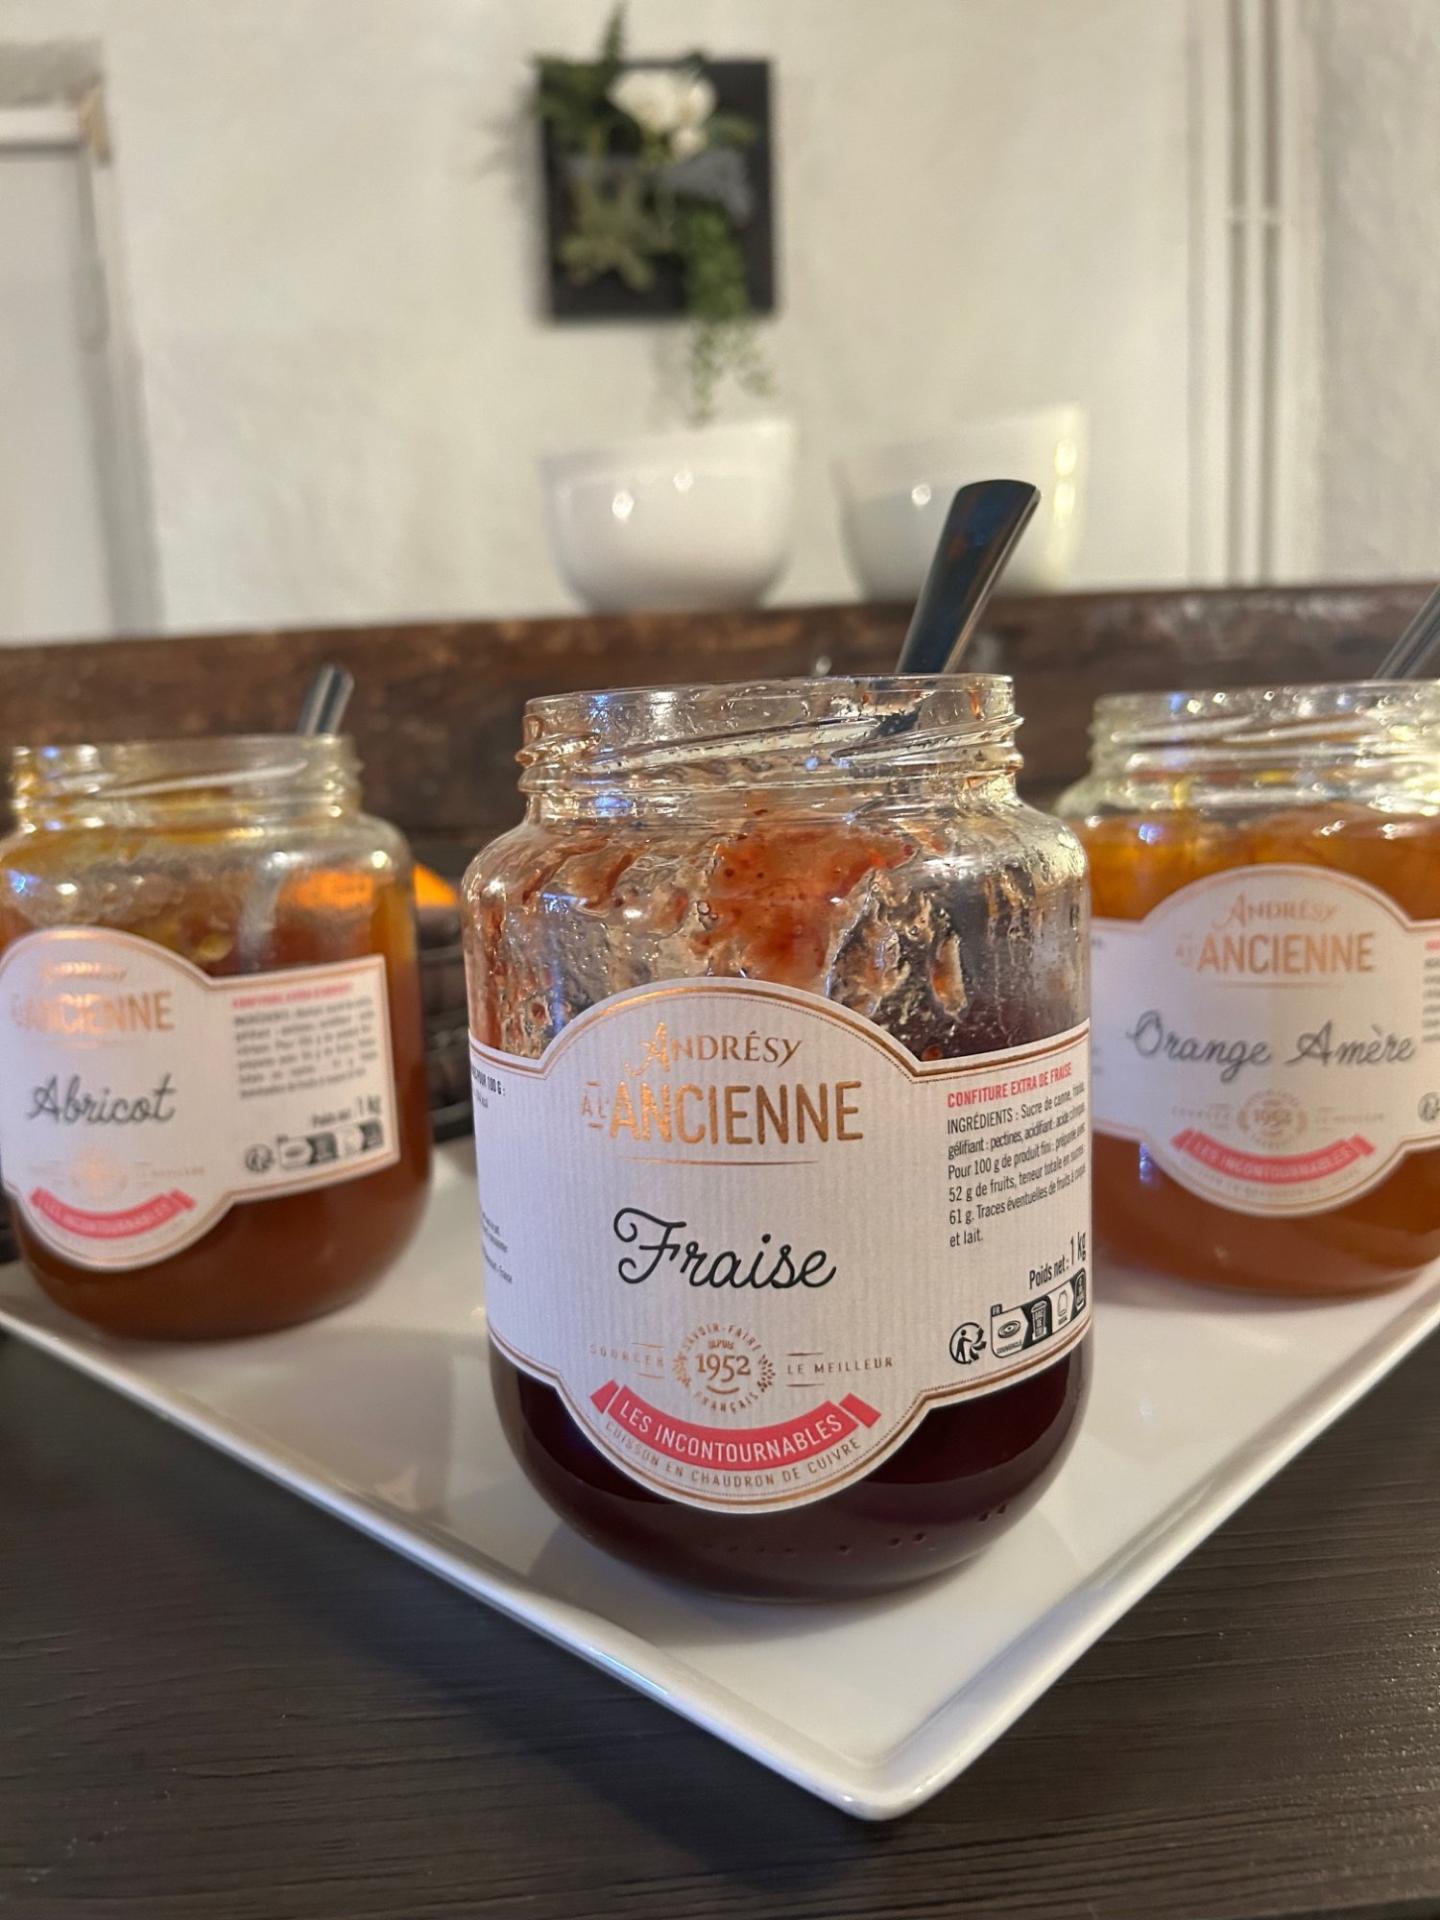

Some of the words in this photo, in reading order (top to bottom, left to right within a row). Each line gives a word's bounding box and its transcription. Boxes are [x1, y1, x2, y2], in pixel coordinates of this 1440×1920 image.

[1197, 931, 1376, 974] ANCIENNE
[623, 1022, 801, 1077] ANDRÉSY
[1126, 1010, 1273, 1084] Orange
[1284, 1020, 1416, 1067] Amère
[27, 1072, 177, 1124] Abricot
[947, 1083, 1008, 1108] CONFITURE
[1011, 1075, 1037, 1095] EXTRA
[1039, 1070, 1049, 1088] DE
[1050, 1062, 1072, 1084] FRAISE
[609, 1080, 864, 1146] ANCIENNE
[947, 1107, 1013, 1134] INGRÉDIENTS
[1021, 1103, 1042, 1119] Sucre
[1044, 1096, 1052, 1111] de
[948, 1138, 984, 1160] gélifiant
[948, 1164, 971, 1180] Pour
[974, 1157, 992, 1175] 100
[993, 1159, 1000, 1174] g
[1001, 1154, 1012, 1169] de
[1013, 1144, 1040, 1168] produit
[949, 1186, 962, 1202] 52
[966, 1187, 973, 1201] g
[975, 1182, 988, 1197] de
[990, 1175, 1017, 1194] fruits,
[1018, 1166, 1043, 1186] teneur
[949, 1208, 962, 1225] 61
[965, 1210, 974, 1224] g.
[976, 1201, 1006, 1220] Traces
[1048, 1180, 1056, 1195] de
[613, 1207, 837, 1289] Fraise
[949, 1231, 960, 1247] et
[1029, 1262, 1052, 1290] Poids
[1054, 1254, 1065, 1277] net
[1070, 1235, 1075, 1265] 1
[1077, 1230, 1086, 1261] kg
[694, 1352, 751, 1383] 1952
[787, 1364, 804, 1375] LE
[814, 1357, 893, 1374] MEILLEUR
[620, 1400, 648, 1433] LES
[654, 1413, 843, 1463] INCONTOURNABLES
[605, 1421, 660, 1466] CUISSON
[665, 1460, 685, 1478] EN
[691, 1470, 776, 1489] CHAUDRON
[782, 1467, 801, 1482] DE
[807, 1436, 862, 1475] CUIVRE
